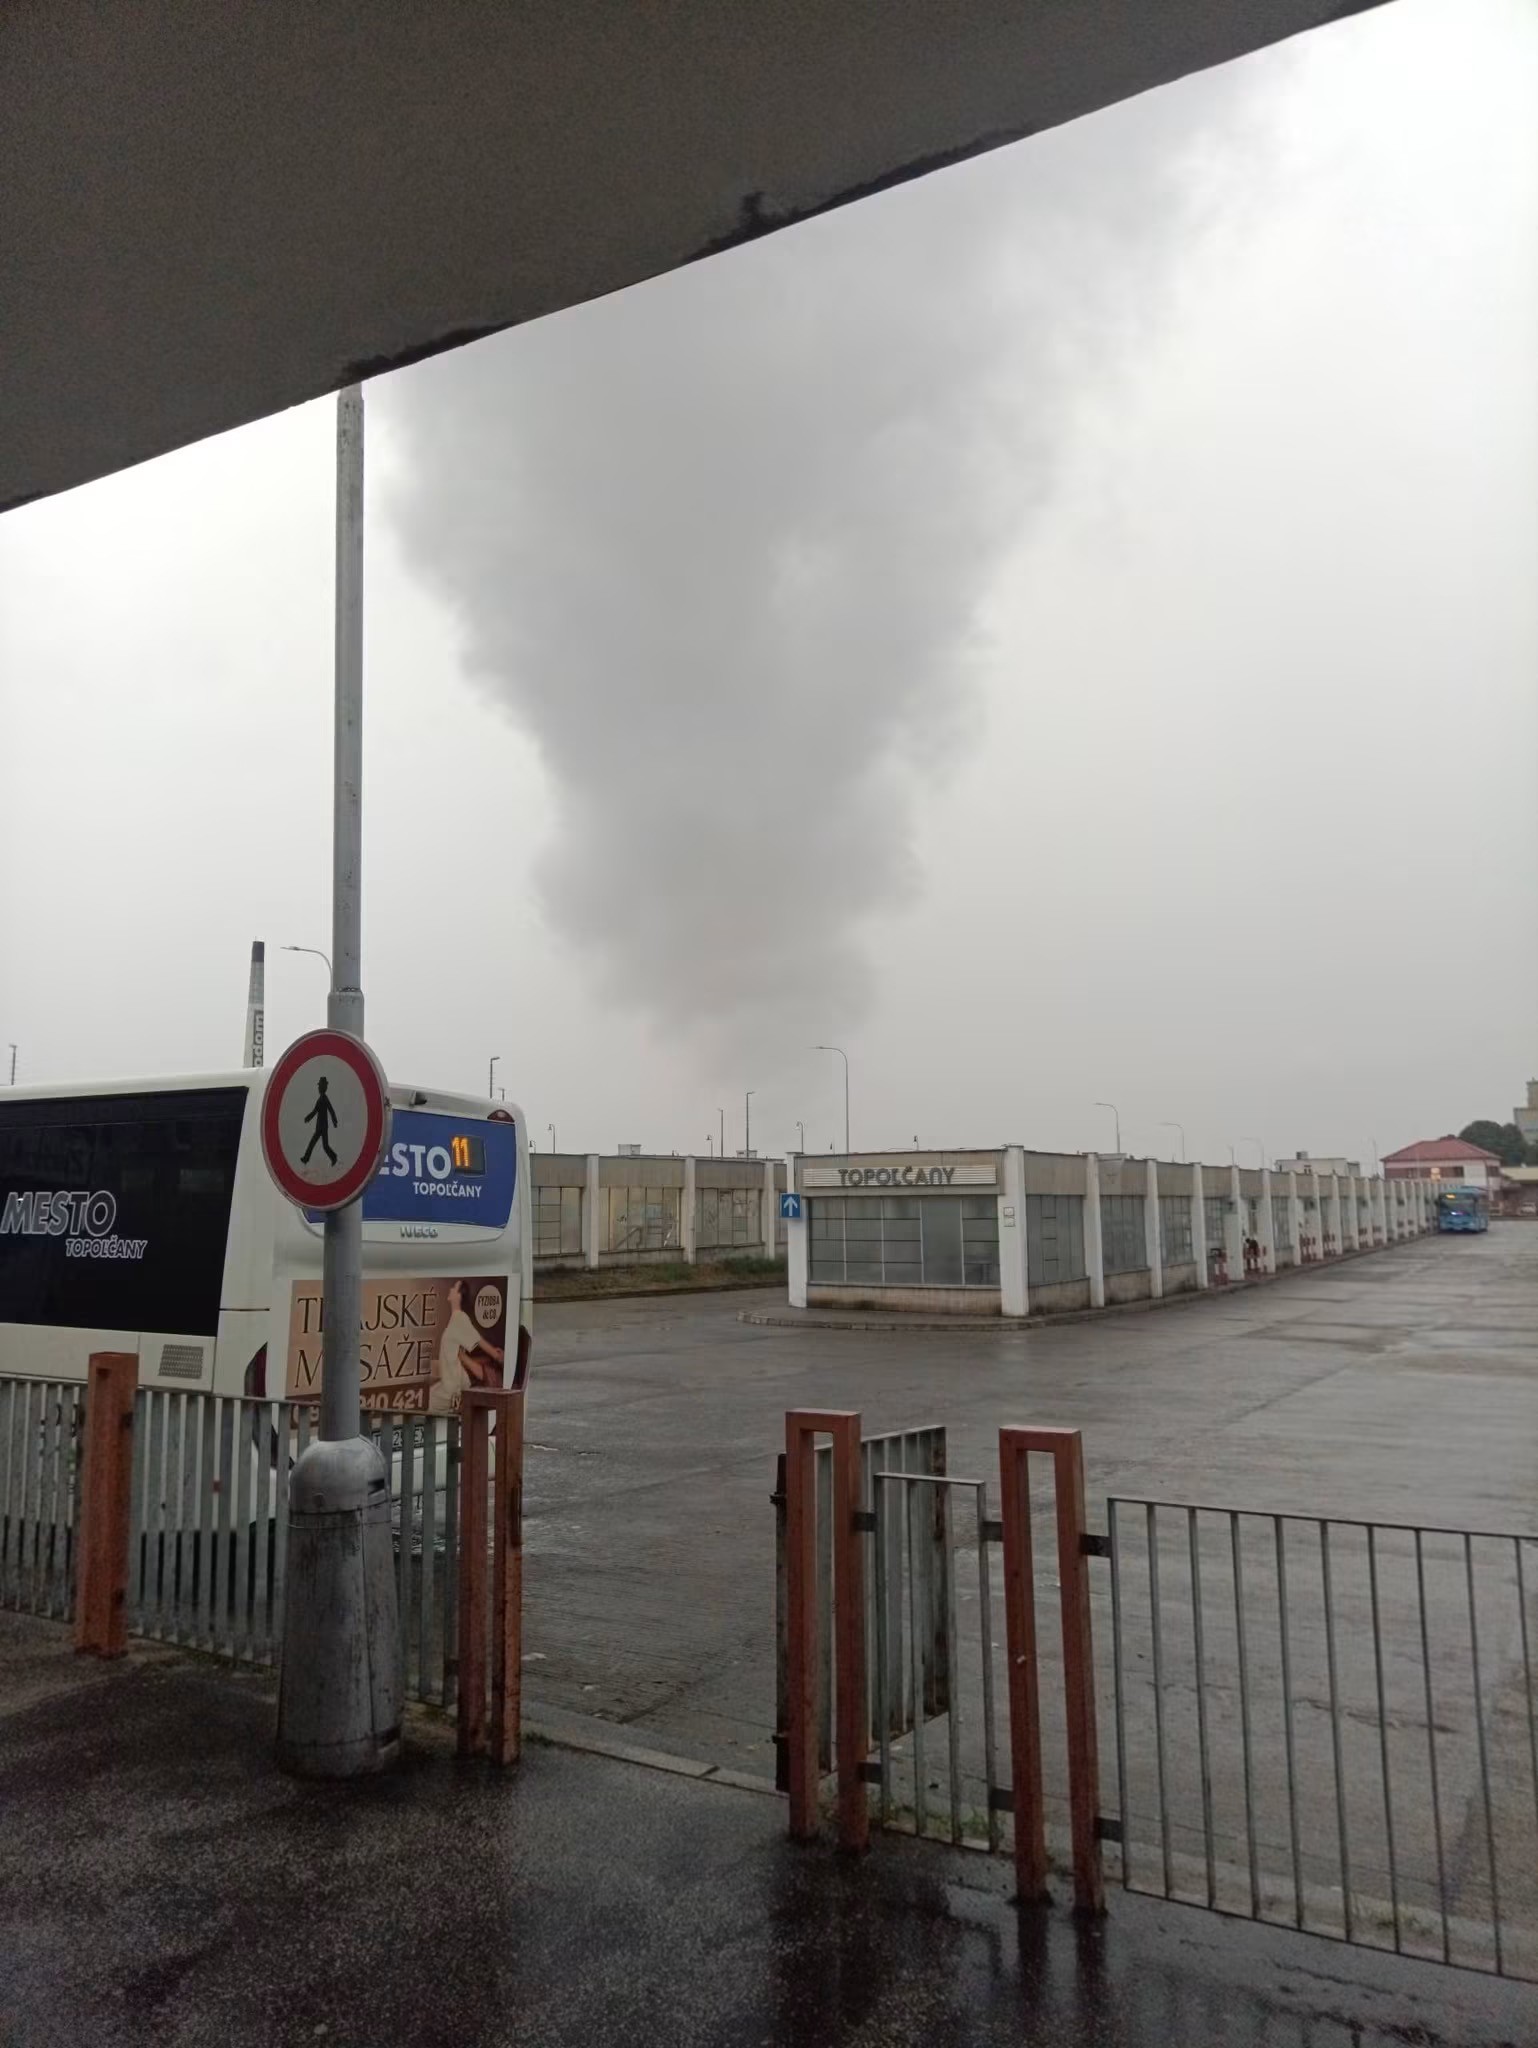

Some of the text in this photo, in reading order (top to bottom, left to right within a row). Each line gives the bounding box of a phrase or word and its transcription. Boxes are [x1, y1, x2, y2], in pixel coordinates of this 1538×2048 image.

[379, 1143, 452, 1180] STO
[452, 1137, 469, 1167] 11
[413, 1181, 482, 1198] TOPOĽČANY
[0, 1190, 117, 1237] MESTO
[65, 1235, 148, 1259] TOPOĽČANY
[297, 1286, 437, 1334] TJSKÉ
[294, 1333, 433, 1388] MSÁŽE
[392, 1389, 423, 1409] 421
